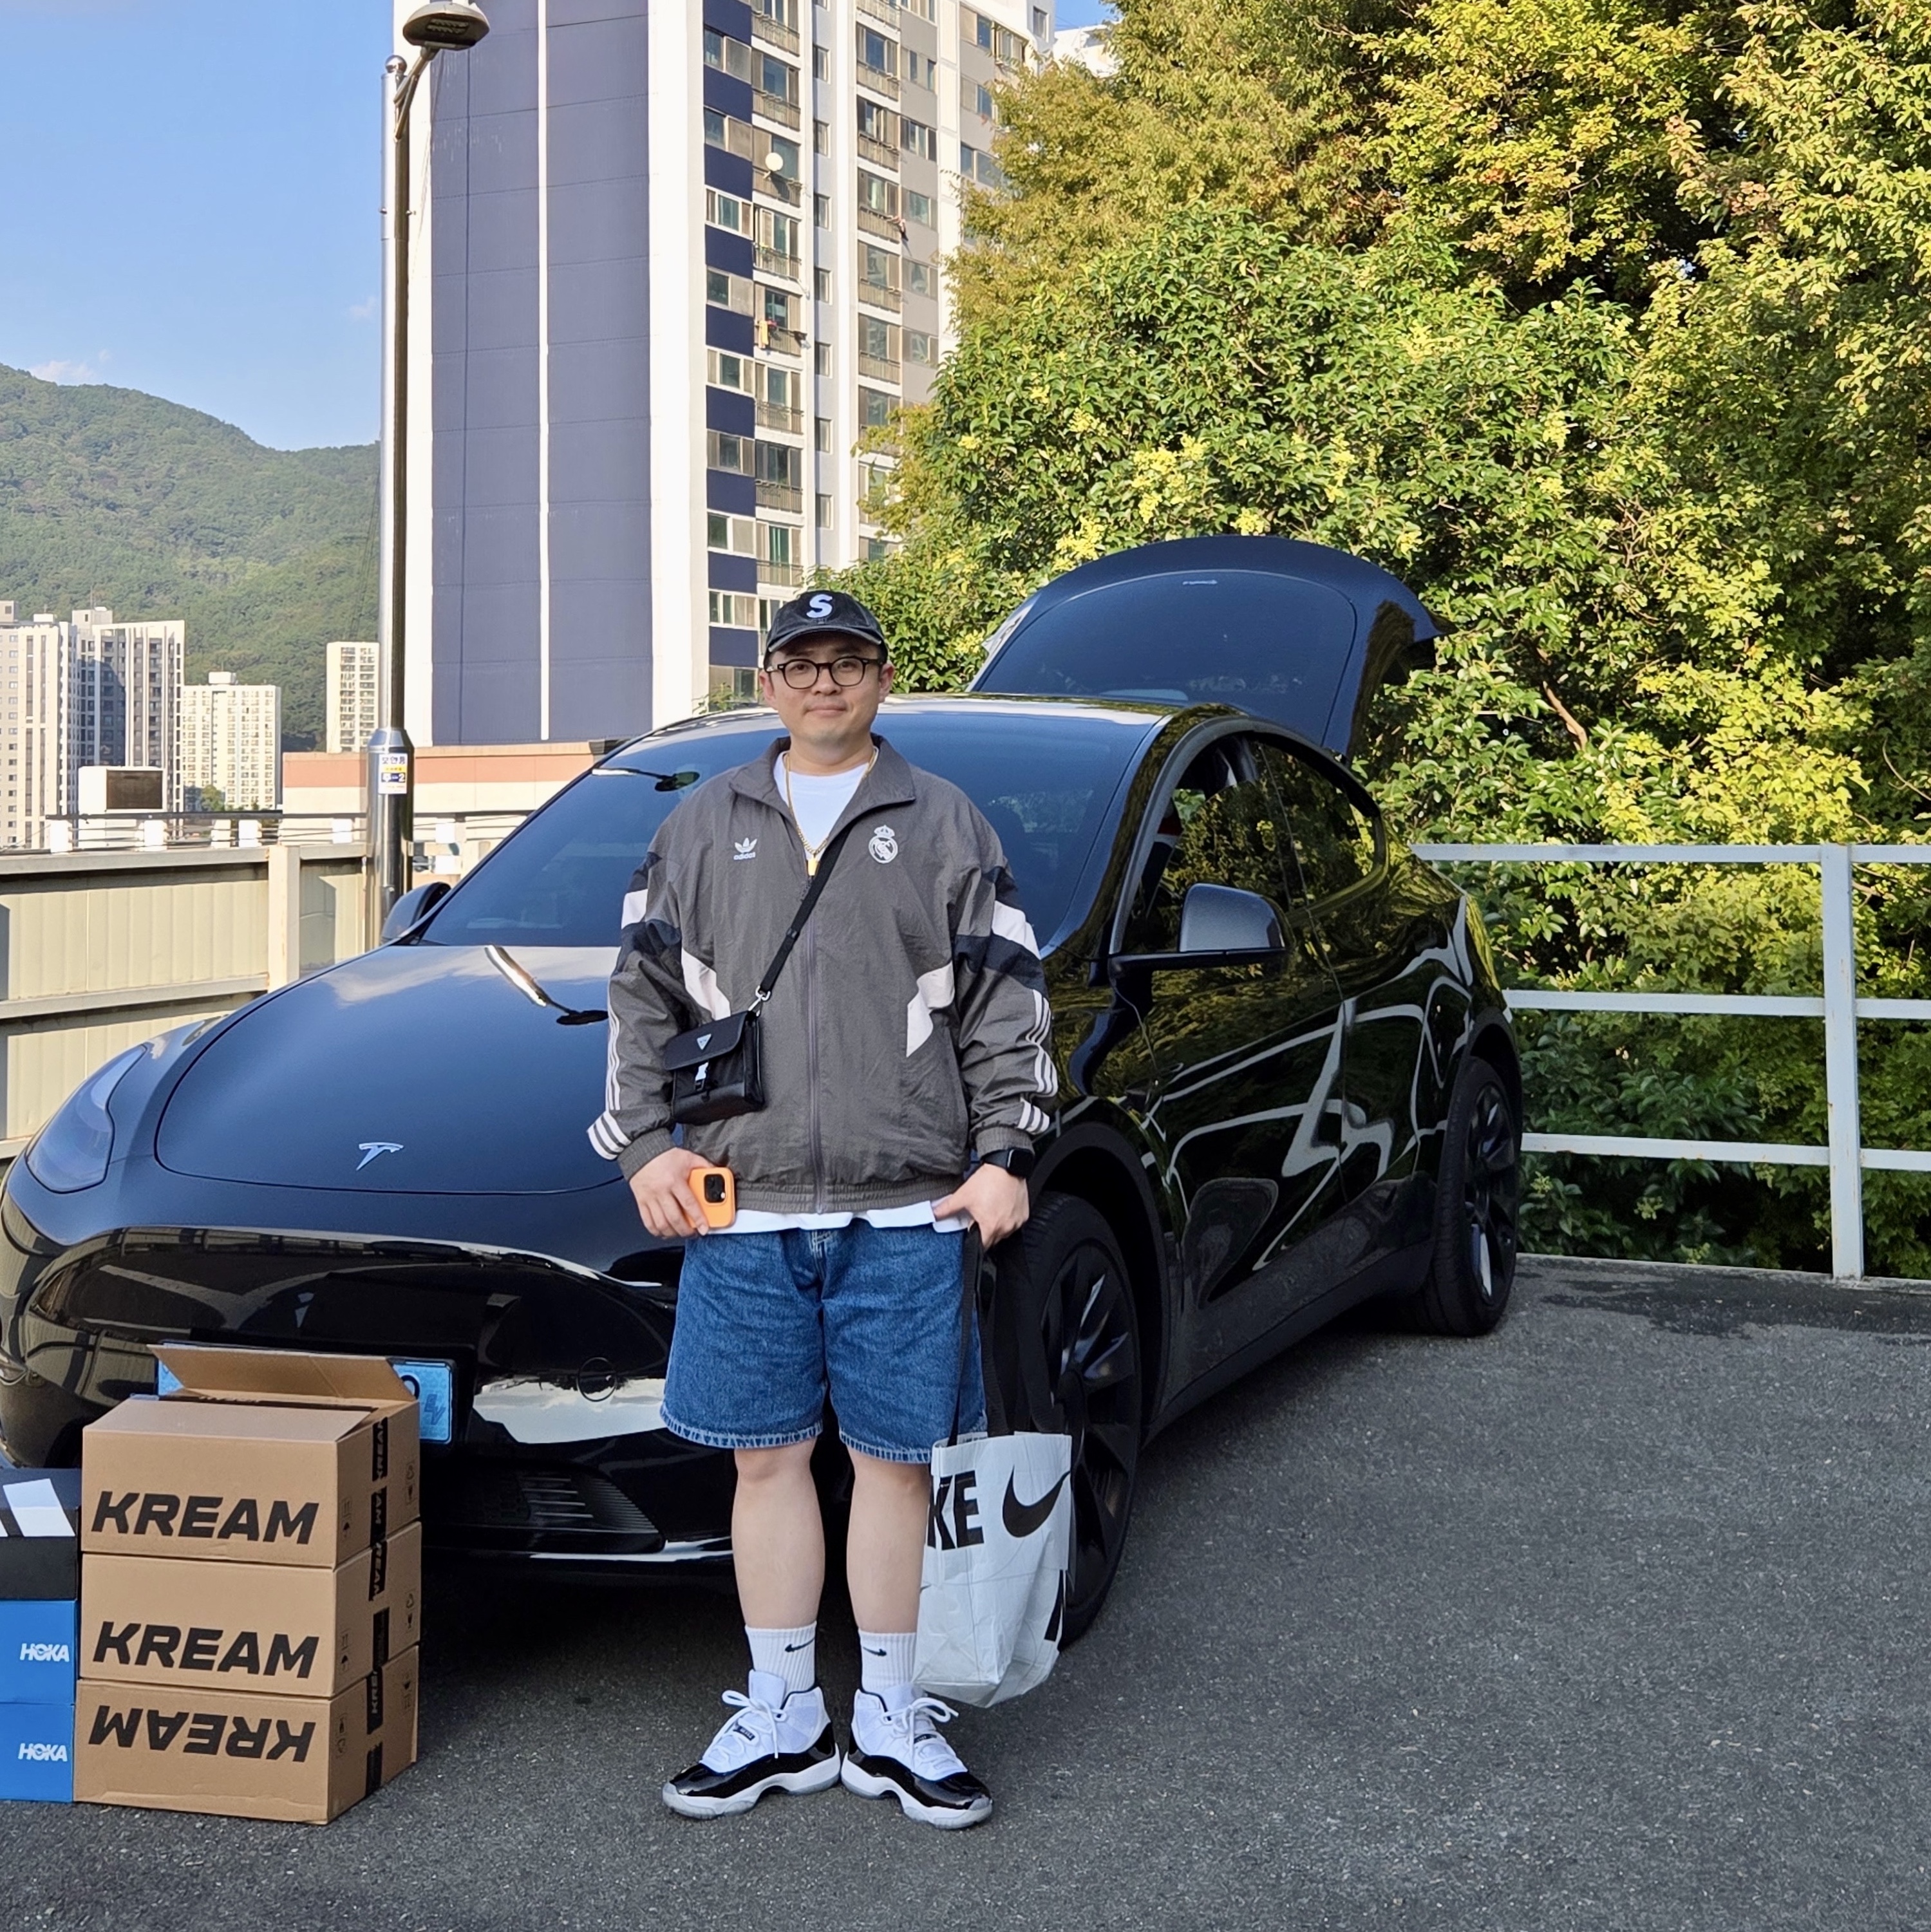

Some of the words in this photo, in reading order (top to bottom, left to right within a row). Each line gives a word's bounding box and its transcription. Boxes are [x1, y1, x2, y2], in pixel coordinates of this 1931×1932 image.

[806, 594, 833, 618] S
[91, 1490, 319, 1545] KREAM
[927, 1470, 984, 1551] KE
[19, 1643, 70, 1662] HOKA
[93, 1620, 319, 1679] KREAM
[17, 1743, 68, 1762] HOKA
[88, 1705, 316, 1763] KREAM
